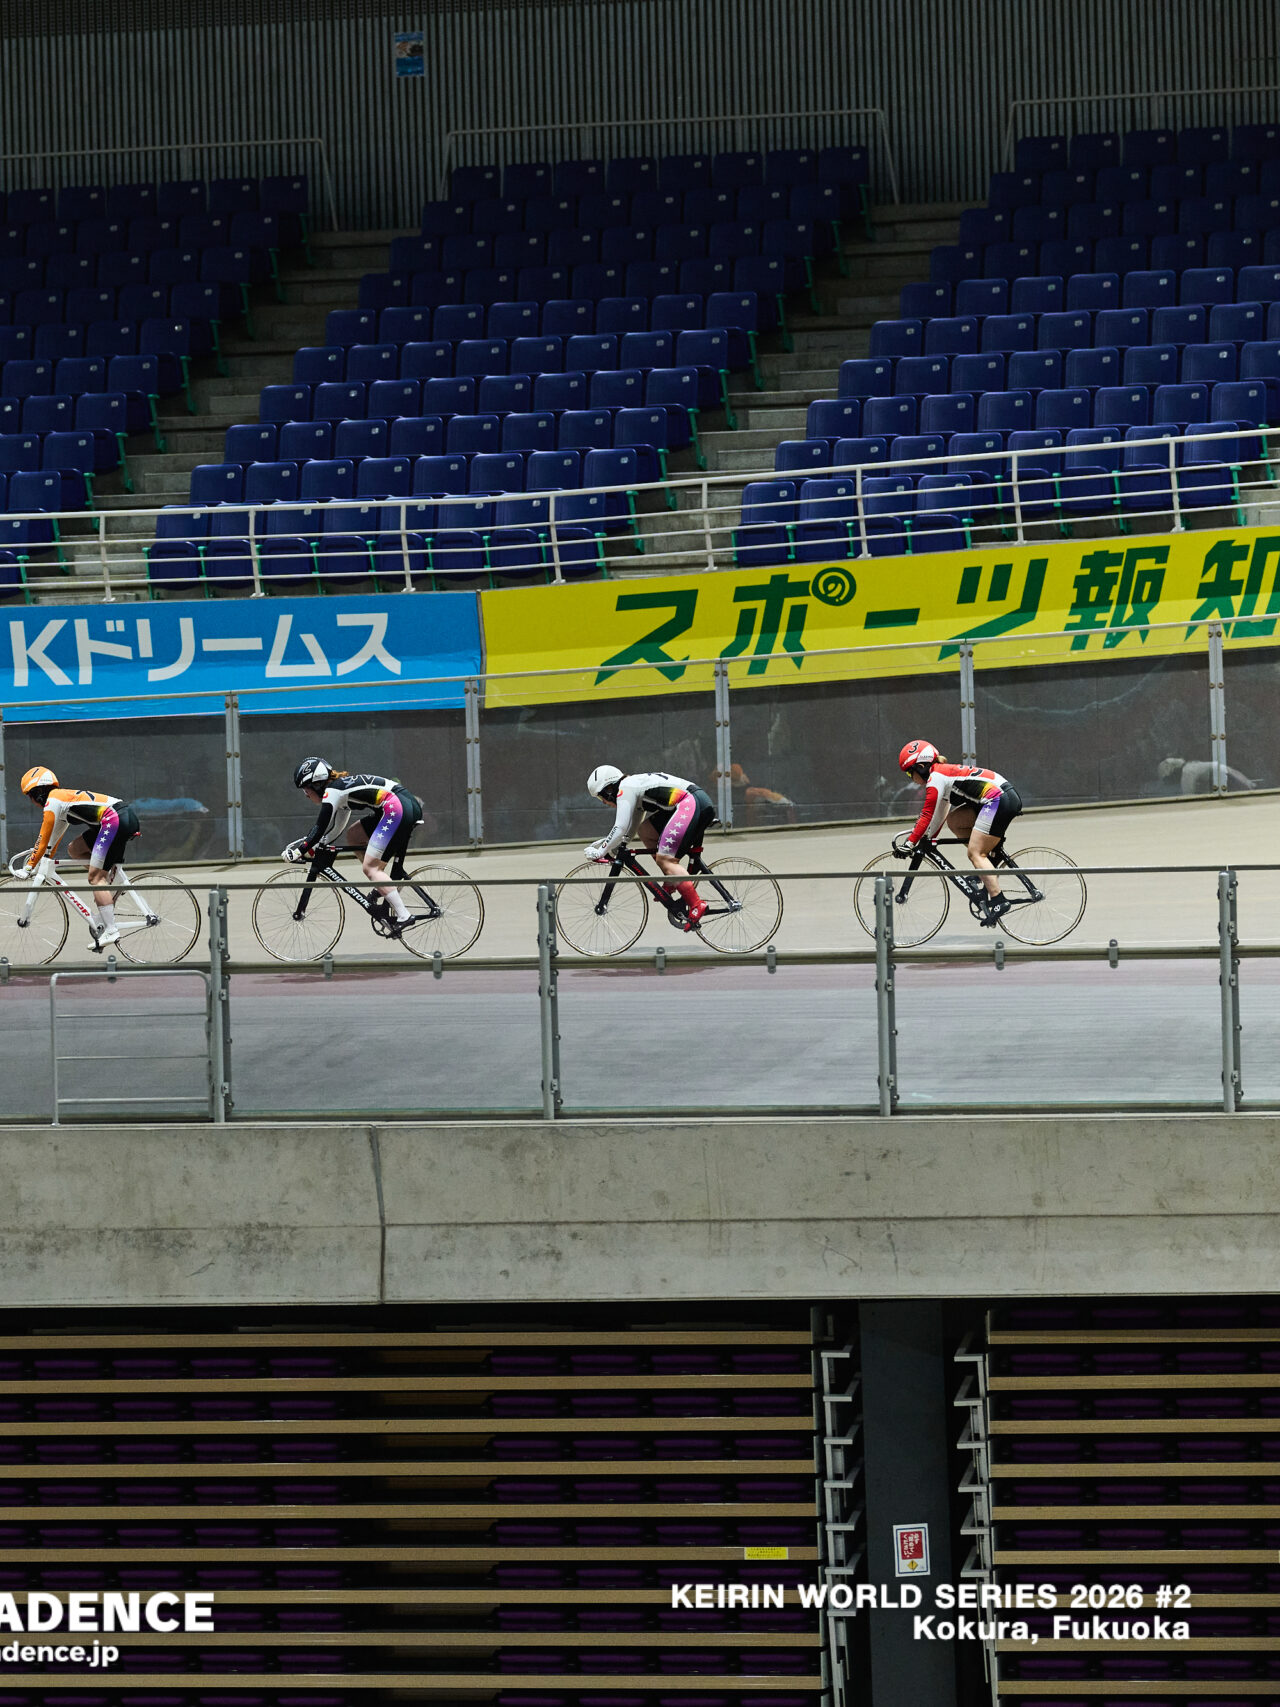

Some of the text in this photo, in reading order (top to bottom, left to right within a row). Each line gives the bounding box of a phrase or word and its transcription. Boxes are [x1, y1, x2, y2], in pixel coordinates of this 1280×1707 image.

[9, 612, 402, 688] Kドリームス
[907, 742, 919, 754] 3
